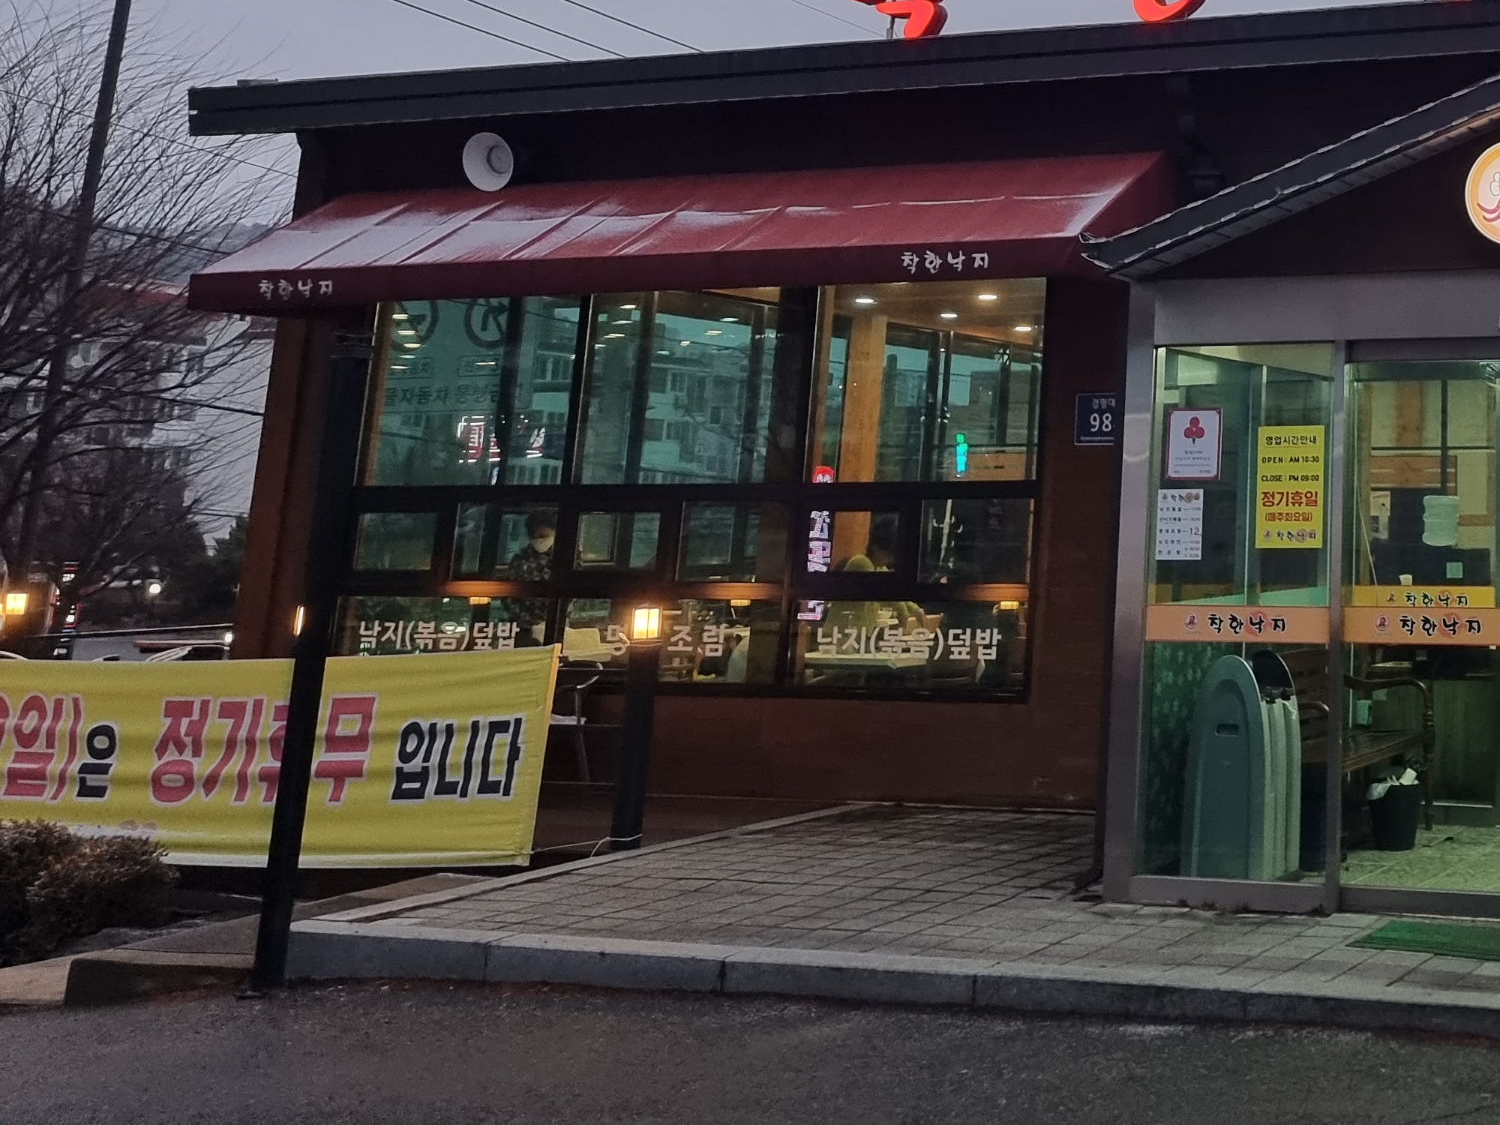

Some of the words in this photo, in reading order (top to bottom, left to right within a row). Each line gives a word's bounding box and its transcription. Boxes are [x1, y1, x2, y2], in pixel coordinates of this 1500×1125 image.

[901, 250, 989, 274] 착한낙지
[258, 279, 333, 300] 착한낙지
[1090, 413, 1115, 432] 98
[1265, 435, 1317, 446] 영업시간안내
[1261, 456, 1284, 464] OPEN
[1301, 455, 1320, 463] 10:30
[1261, 491, 1318, 507] 정기휴일
[1405, 593, 1469, 607] 착한낙지
[1207, 613, 1287, 635] 착한낙지
[1399, 615, 1482, 637] 착한낙지
[359, 620, 520, 653] 낙지(볶음)덮밥
[816, 626, 1002, 661] 낙지(볶음)덮밥
[0, 695, 117, 800] 일)은
[390, 717, 524, 801] 입니다
